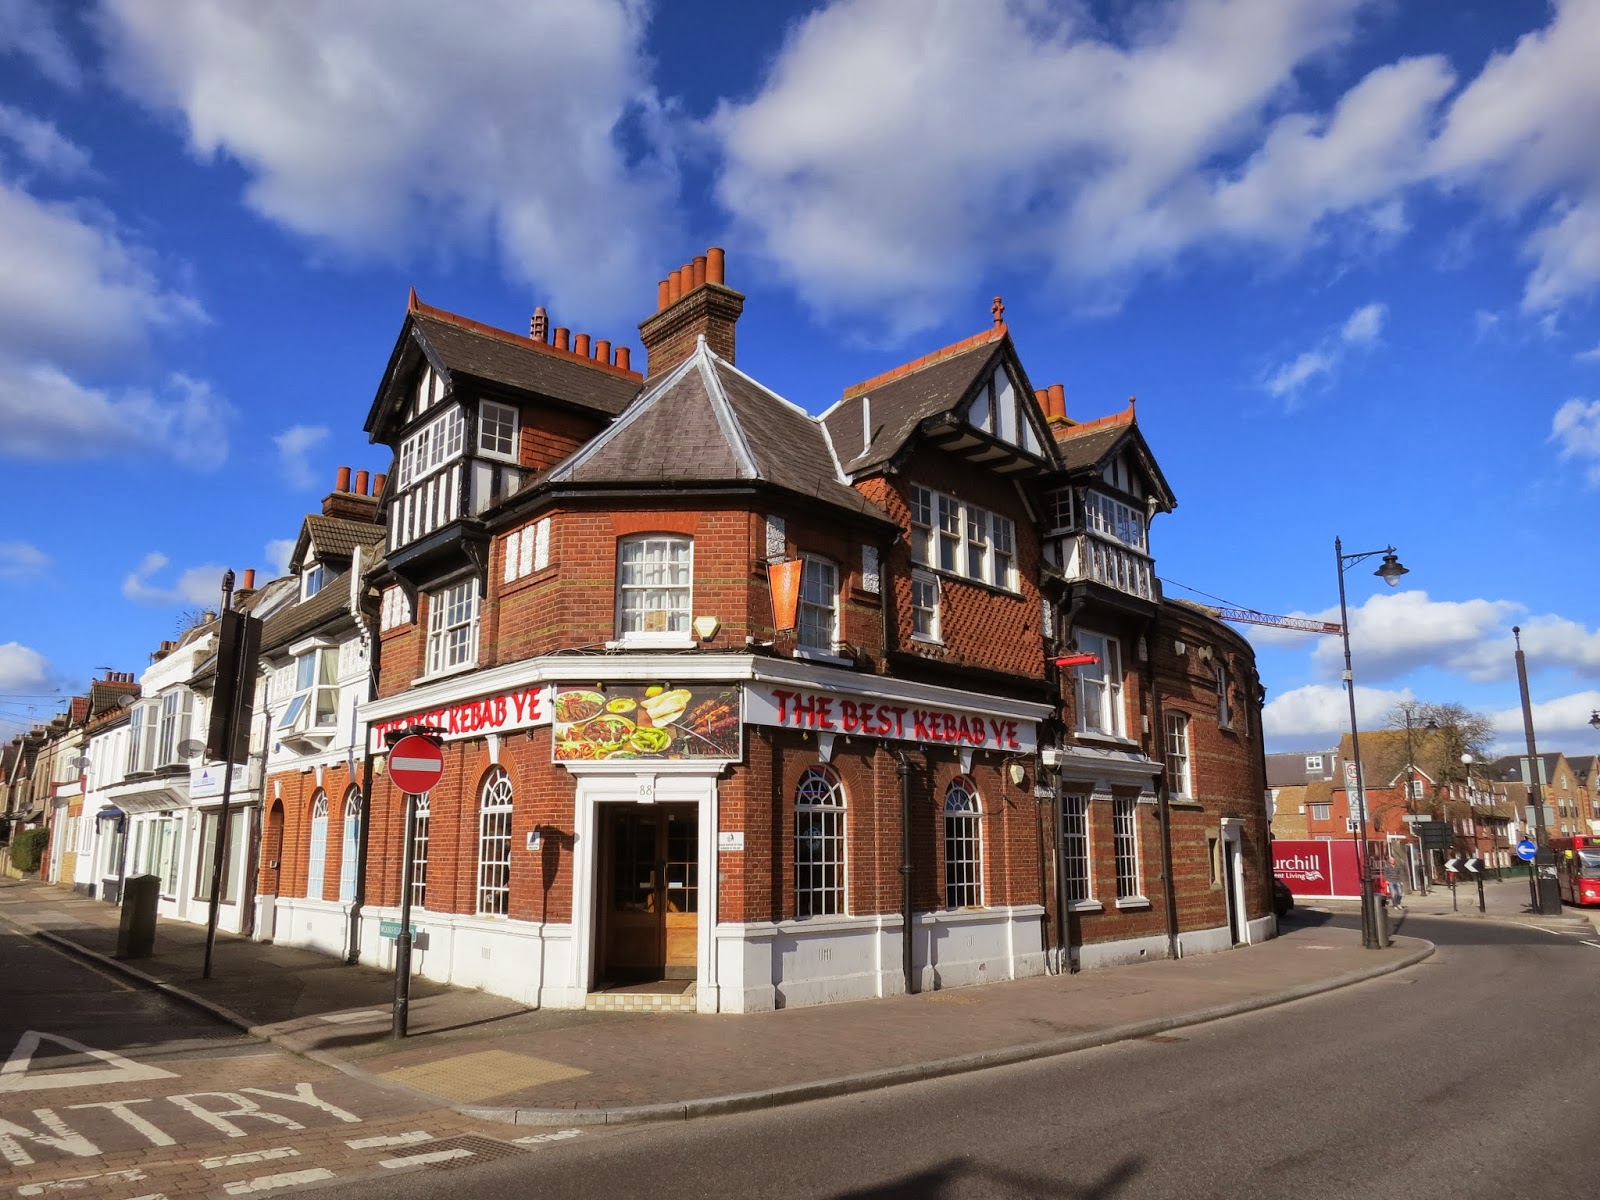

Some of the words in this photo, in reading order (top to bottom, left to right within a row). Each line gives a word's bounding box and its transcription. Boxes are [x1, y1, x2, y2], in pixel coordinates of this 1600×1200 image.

[448, 695, 507, 735] KEBAB
[511, 687, 542, 723] YE
[772, 689, 834, 729] THE
[839, 699, 908, 736] BEST
[912, 709, 986, 745] KEBAB
[990, 718, 1020, 748] YE
[640, 784, 653, 796] 88
[1273, 854, 1320, 870] urchill
[1285, 872, 1306, 880] Living
